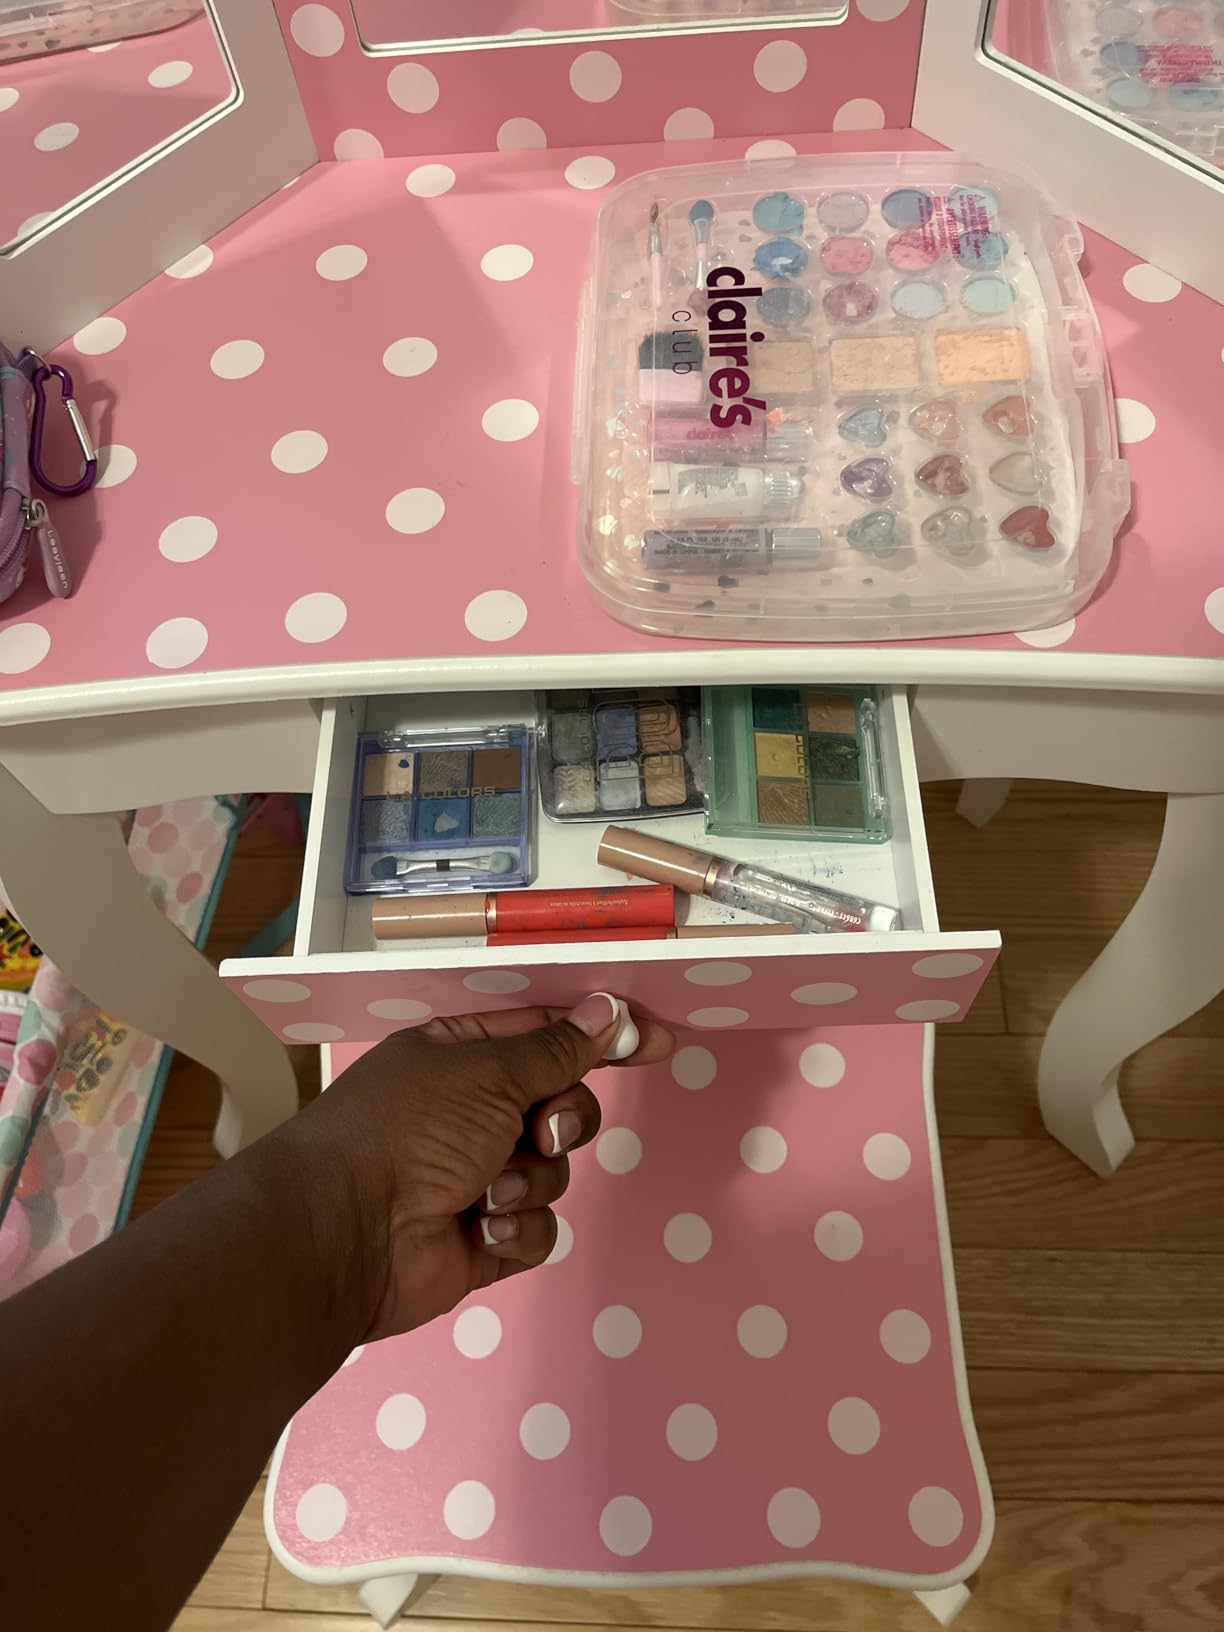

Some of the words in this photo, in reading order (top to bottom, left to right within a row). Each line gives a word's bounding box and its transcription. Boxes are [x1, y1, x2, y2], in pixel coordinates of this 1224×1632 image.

[672, 310, 698, 375] club
[706, 266, 766, 428] claire's
[422, 786, 496, 799] COLORS
